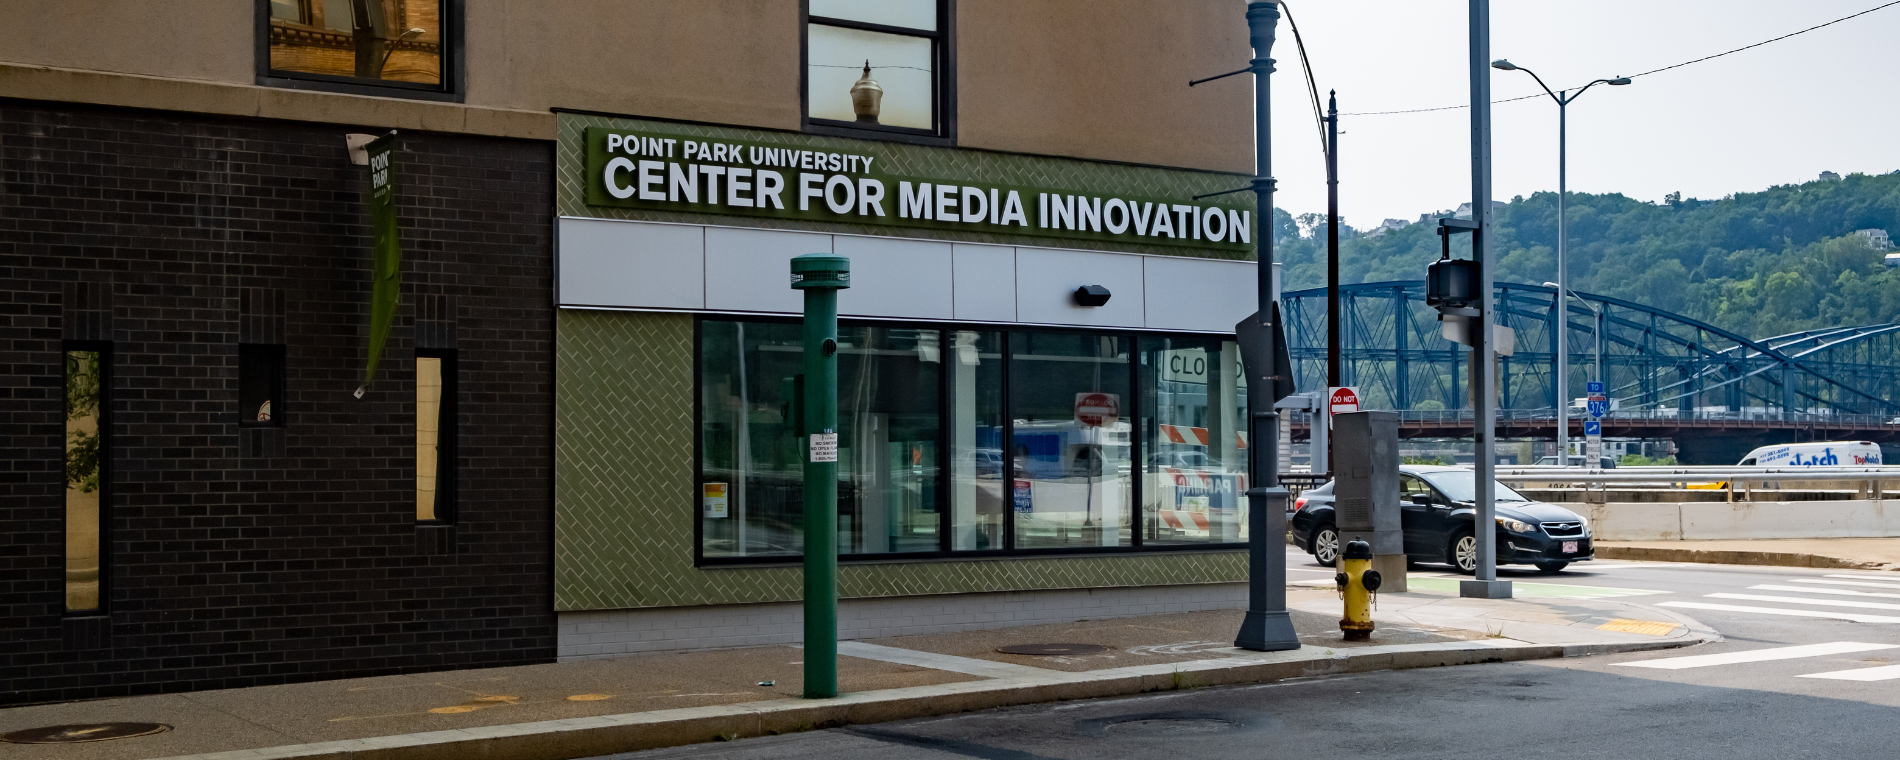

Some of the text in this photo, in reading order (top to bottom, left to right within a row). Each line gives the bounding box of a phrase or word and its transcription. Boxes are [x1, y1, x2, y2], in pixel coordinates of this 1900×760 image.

[608, 133, 874, 174] POINT PARK UNIVERSITY
[604, 156, 1251, 244] CENTER FOR MEDIA INNOVATION
[1343, 395, 1356, 403] NOT
[1590, 401, 1605, 414] 376
